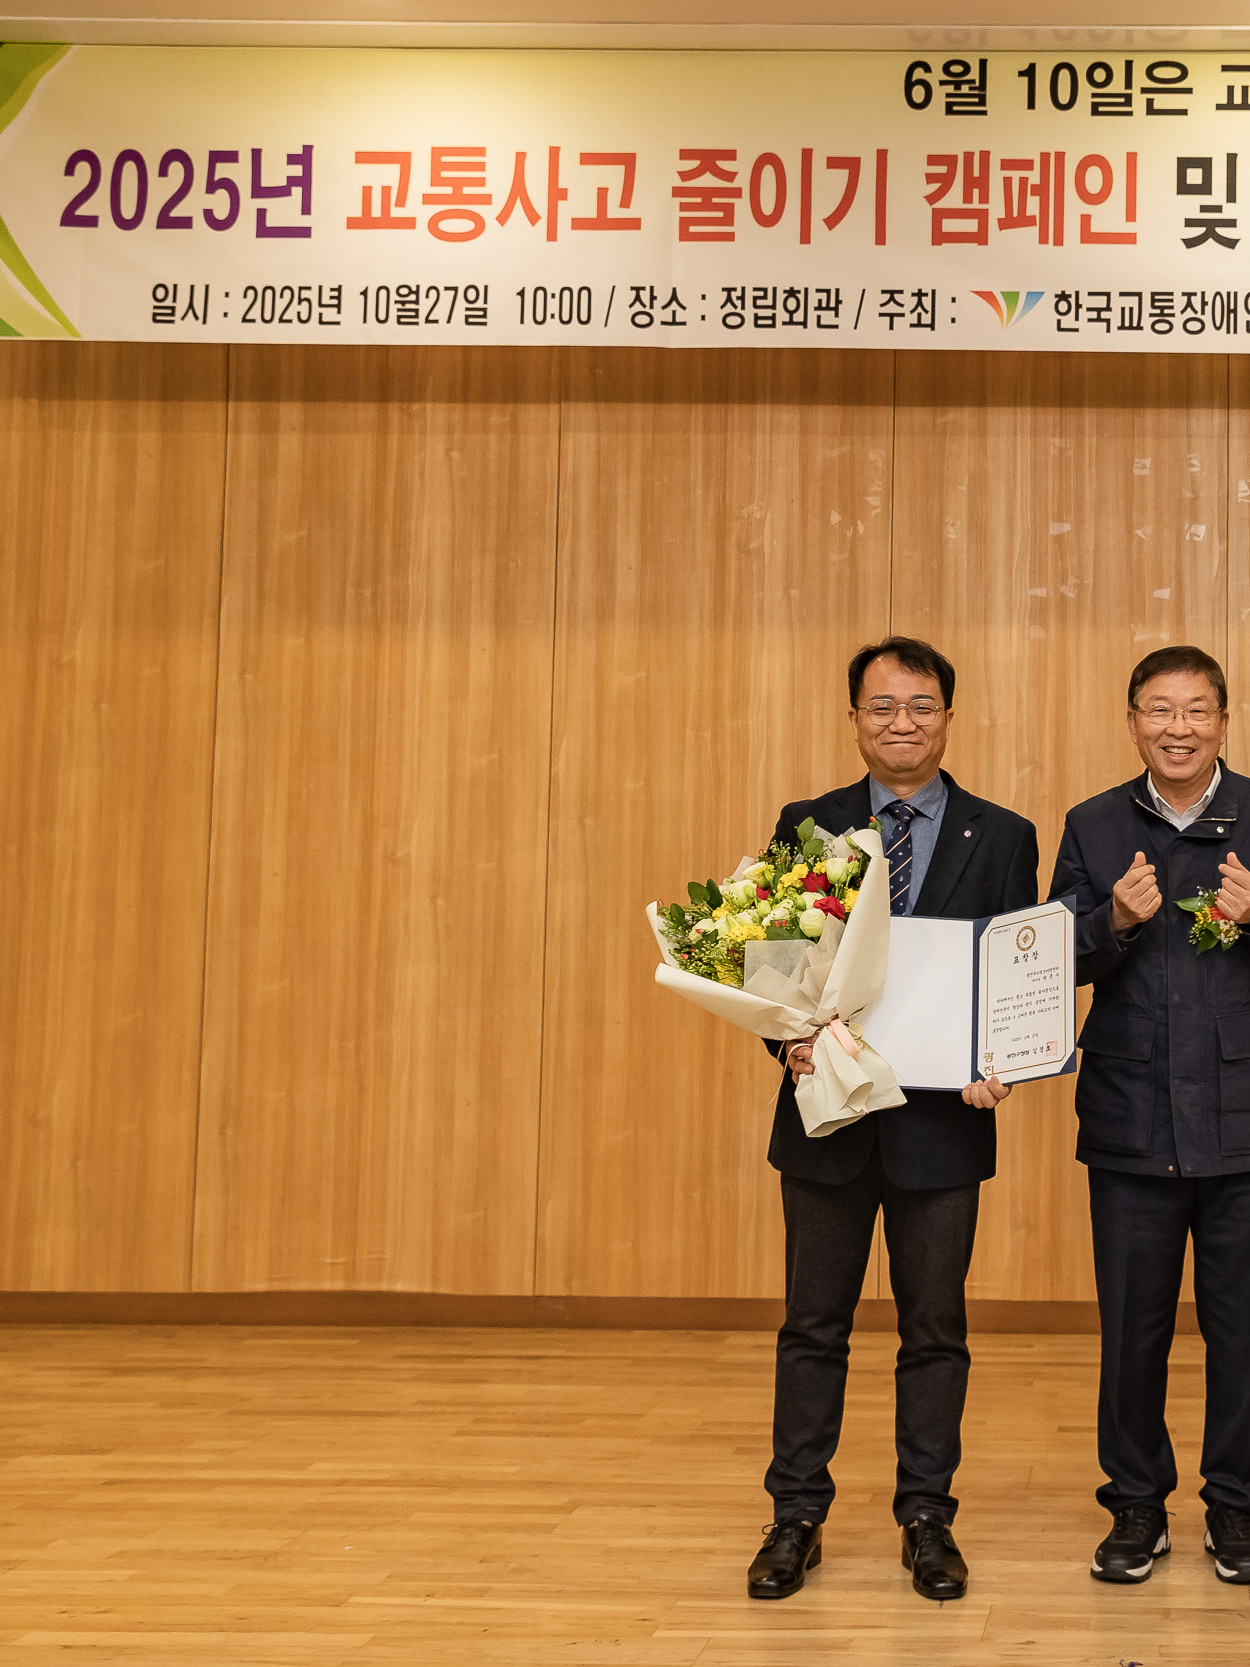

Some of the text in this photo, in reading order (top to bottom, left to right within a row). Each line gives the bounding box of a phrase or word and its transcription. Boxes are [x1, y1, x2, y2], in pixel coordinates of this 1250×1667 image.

[903, 57, 989, 117] 6월
[1017, 59, 1194, 118] 10일은
[60, 145, 315, 240] 2025년
[346, 146, 642, 243] 교통사고
[671, 148, 889, 246] 줄이기
[922, 150, 1139, 247] 캠페인
[1175, 153, 1242, 250] 및
[151, 283, 211, 326] 일시
[241, 284, 344, 327] 2025년
[359, 284, 489, 327] 10월27일
[515, 286, 593, 326] 10:00
[628, 285, 688, 330] 장소
[719, 286, 844, 331] 정립회관
[877, 288, 937, 332] 주최
